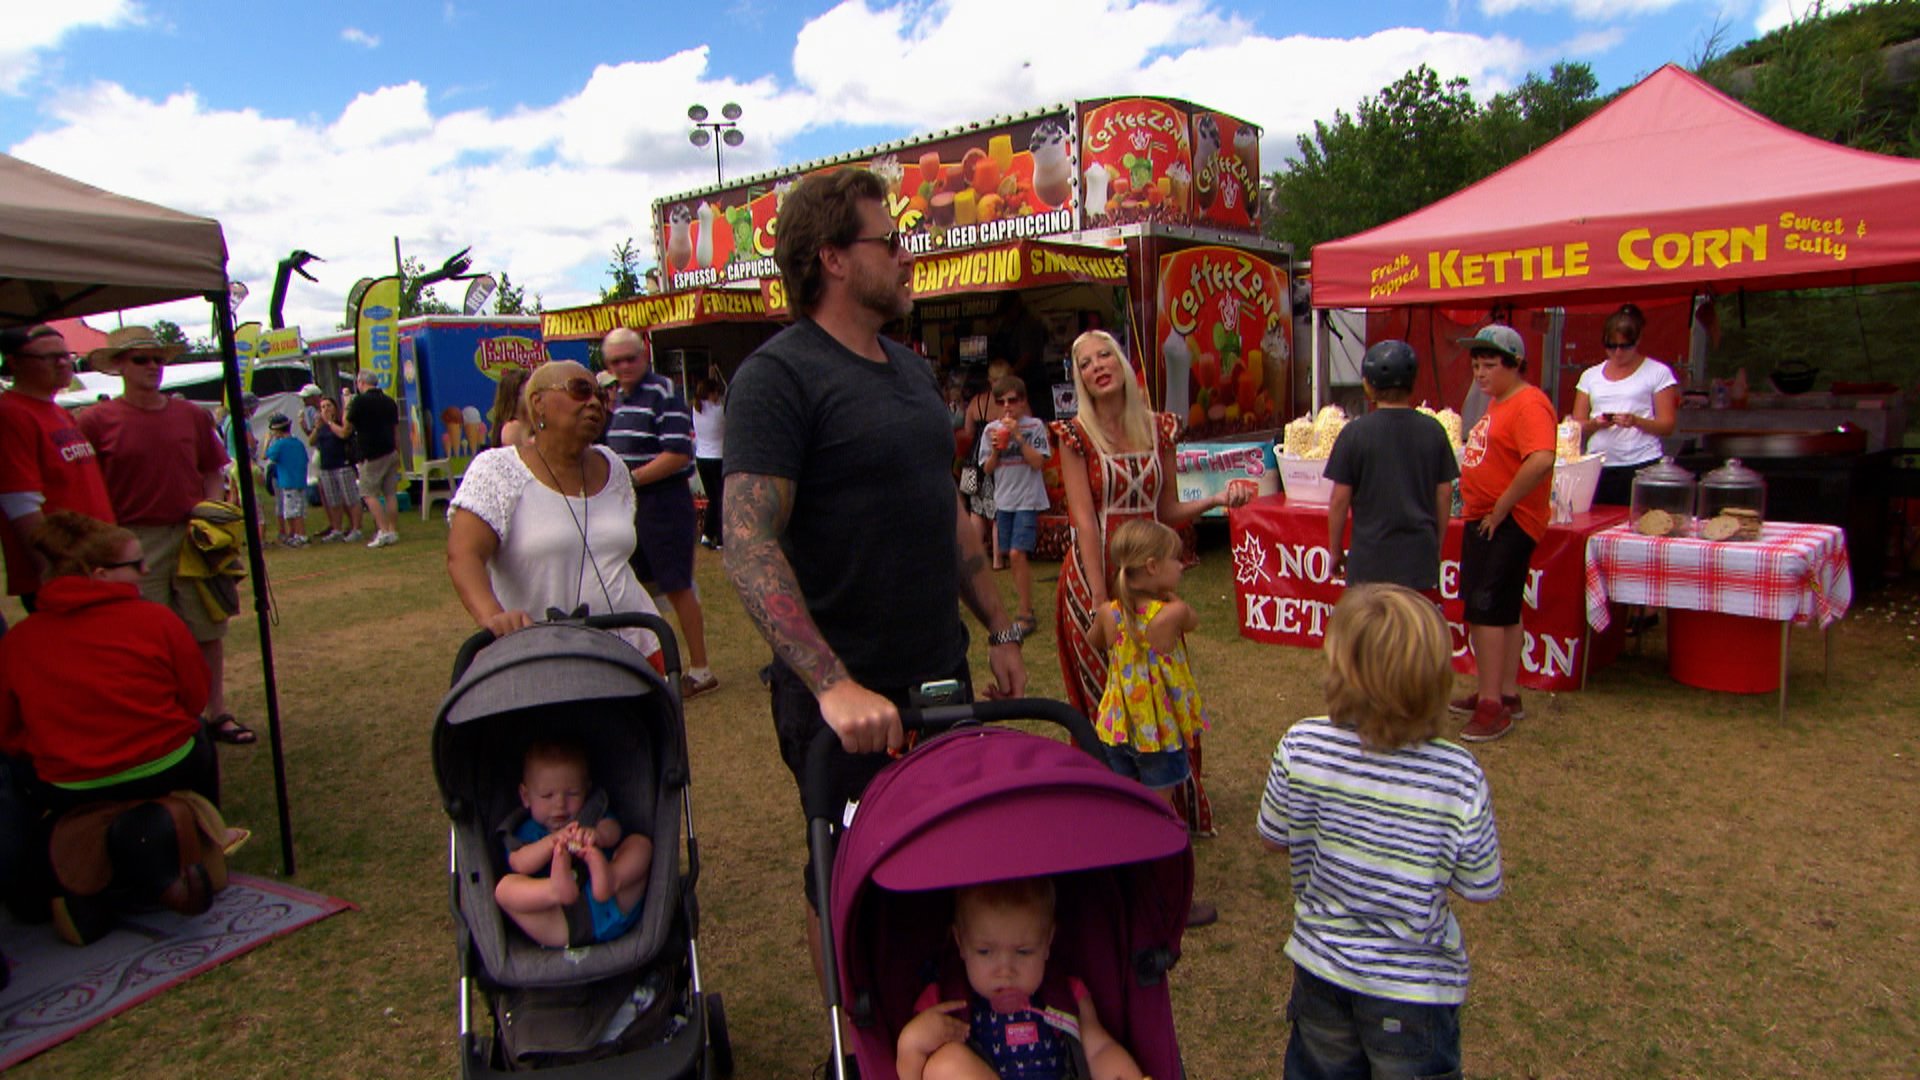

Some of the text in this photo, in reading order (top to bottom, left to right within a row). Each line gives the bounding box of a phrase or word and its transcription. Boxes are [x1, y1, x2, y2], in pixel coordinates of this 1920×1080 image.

[1779, 212, 1844, 235] Sweet
[674, 267, 717, 289] ESPRESSO
[946, 226, 977, 249] ICED
[980, 210, 1071, 243] CAPPUCCINO
[1428, 224, 1768, 289] KETTLE CORN
[1785, 233, 1847, 261] Salty
[913, 248, 1021, 293] CAPPUCINO
[1370, 253, 1411, 283] Fresh
[544, 294, 696, 337] FROZEN HOT CHOCOLATE
[702, 292, 751, 315] FROZEN
